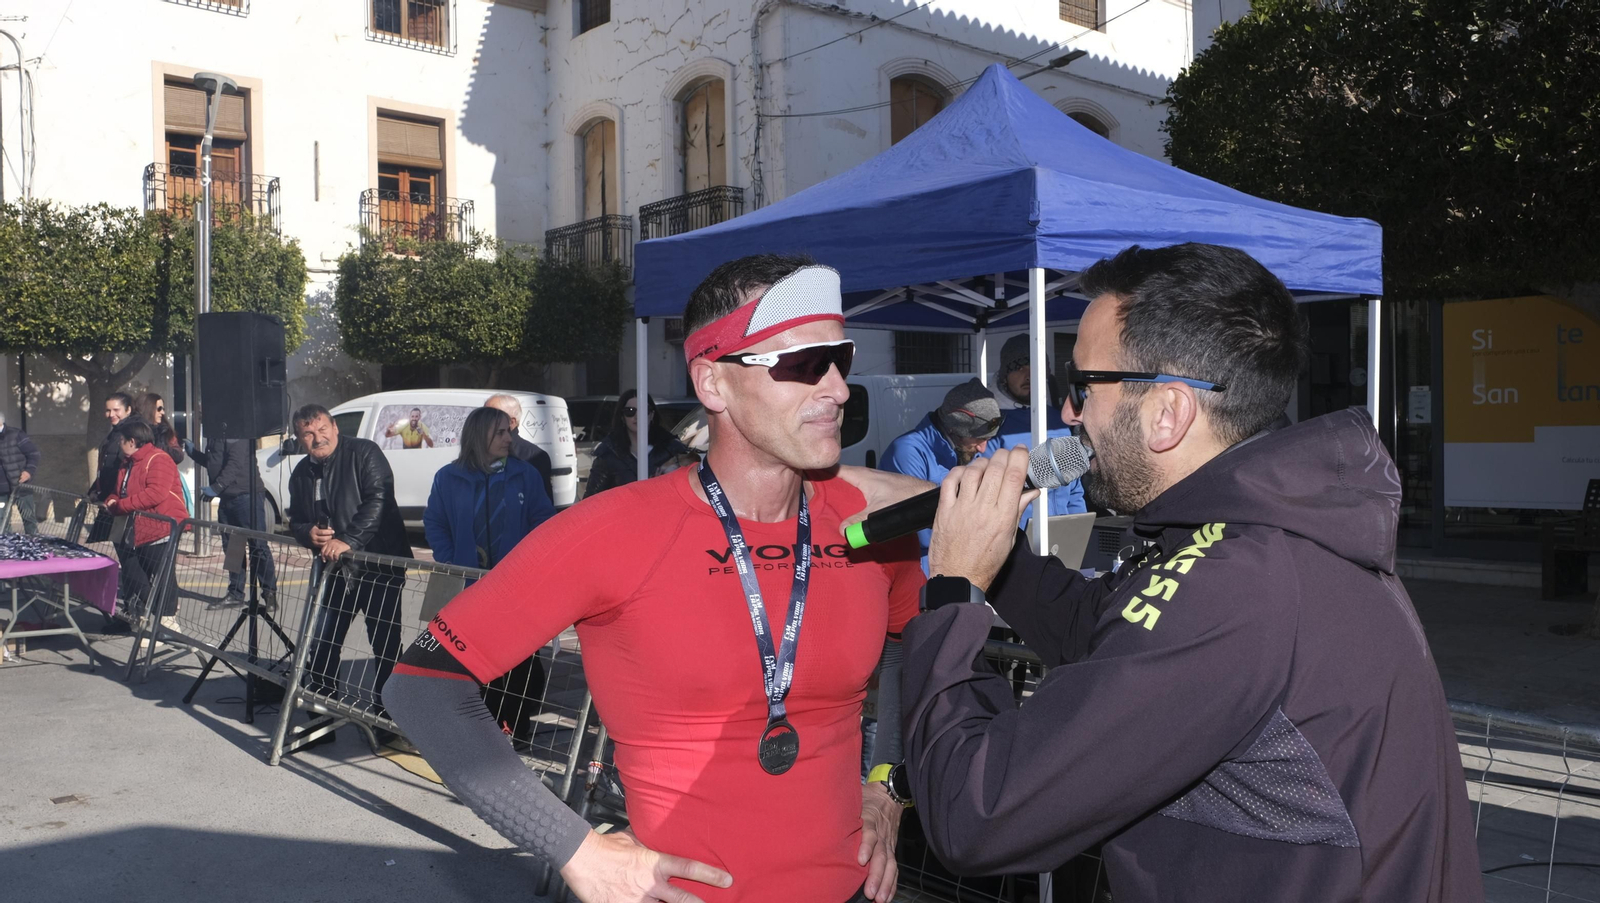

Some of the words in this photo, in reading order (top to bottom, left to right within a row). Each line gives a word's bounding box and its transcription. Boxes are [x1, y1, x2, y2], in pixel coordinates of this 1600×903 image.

[1472, 329, 1492, 350] Si
[1557, 324, 1583, 345] te
[1472, 384, 1519, 405] San
[1562, 456, 1585, 464] Calcula
[709, 561, 854, 575] PEFORANCE
[432, 612, 466, 652] WONG
